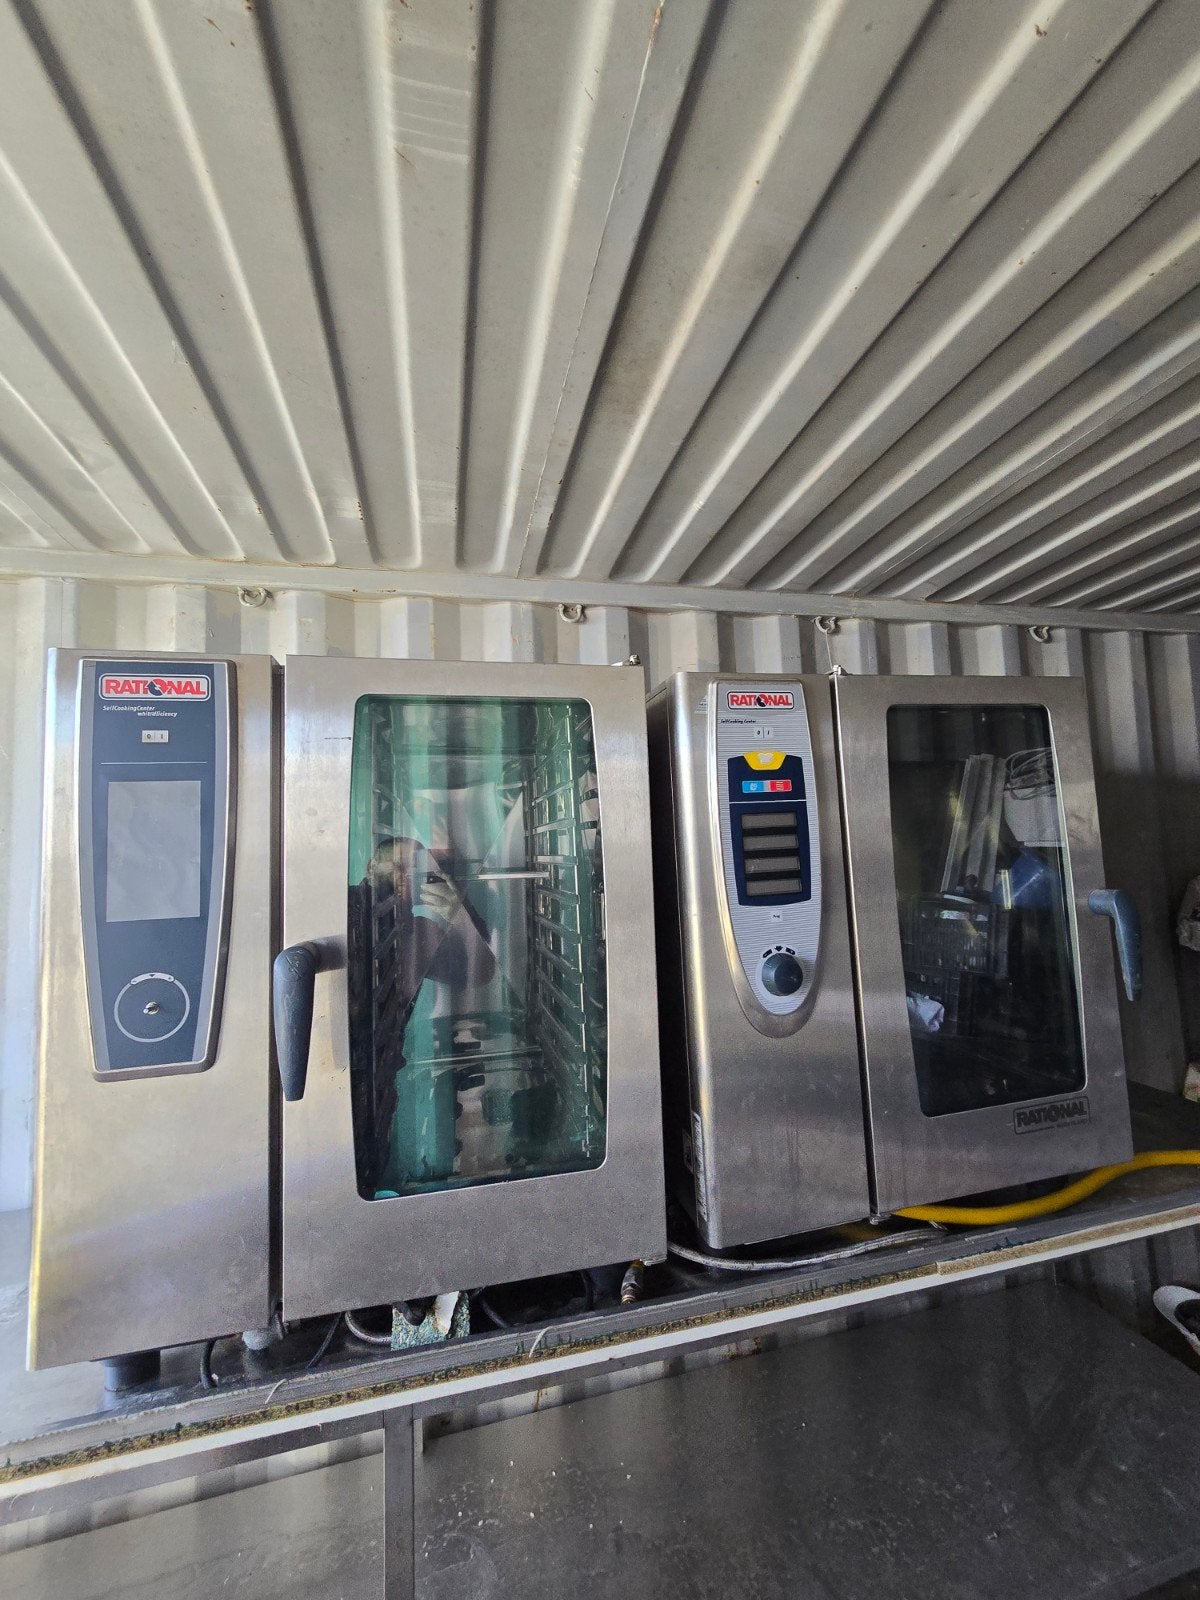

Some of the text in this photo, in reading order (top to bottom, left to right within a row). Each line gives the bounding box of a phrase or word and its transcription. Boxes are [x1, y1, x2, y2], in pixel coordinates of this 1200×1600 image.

[105, 678, 206, 696] RATIONAL
[729, 694, 792, 707] RATIONAL
[1016, 1101, 1088, 1128] RATIONAL
